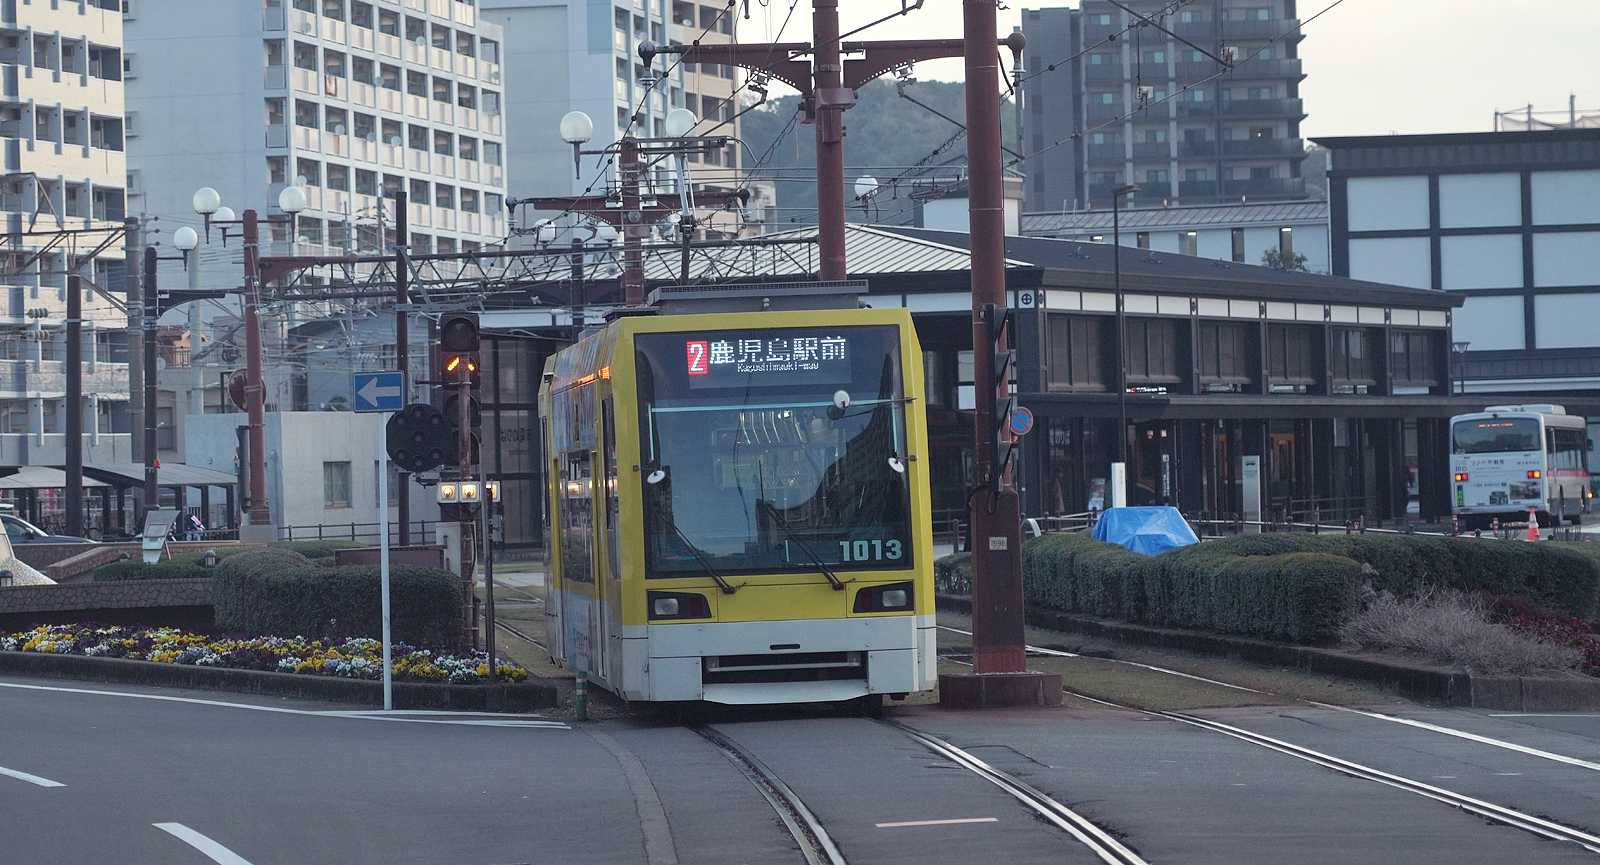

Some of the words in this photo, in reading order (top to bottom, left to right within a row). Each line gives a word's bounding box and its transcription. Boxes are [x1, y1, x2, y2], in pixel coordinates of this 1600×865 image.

[690, 343, 704, 372] 2
[709, 336, 847, 364] 鹿児島駅前
[839, 539, 902, 562] 1013
